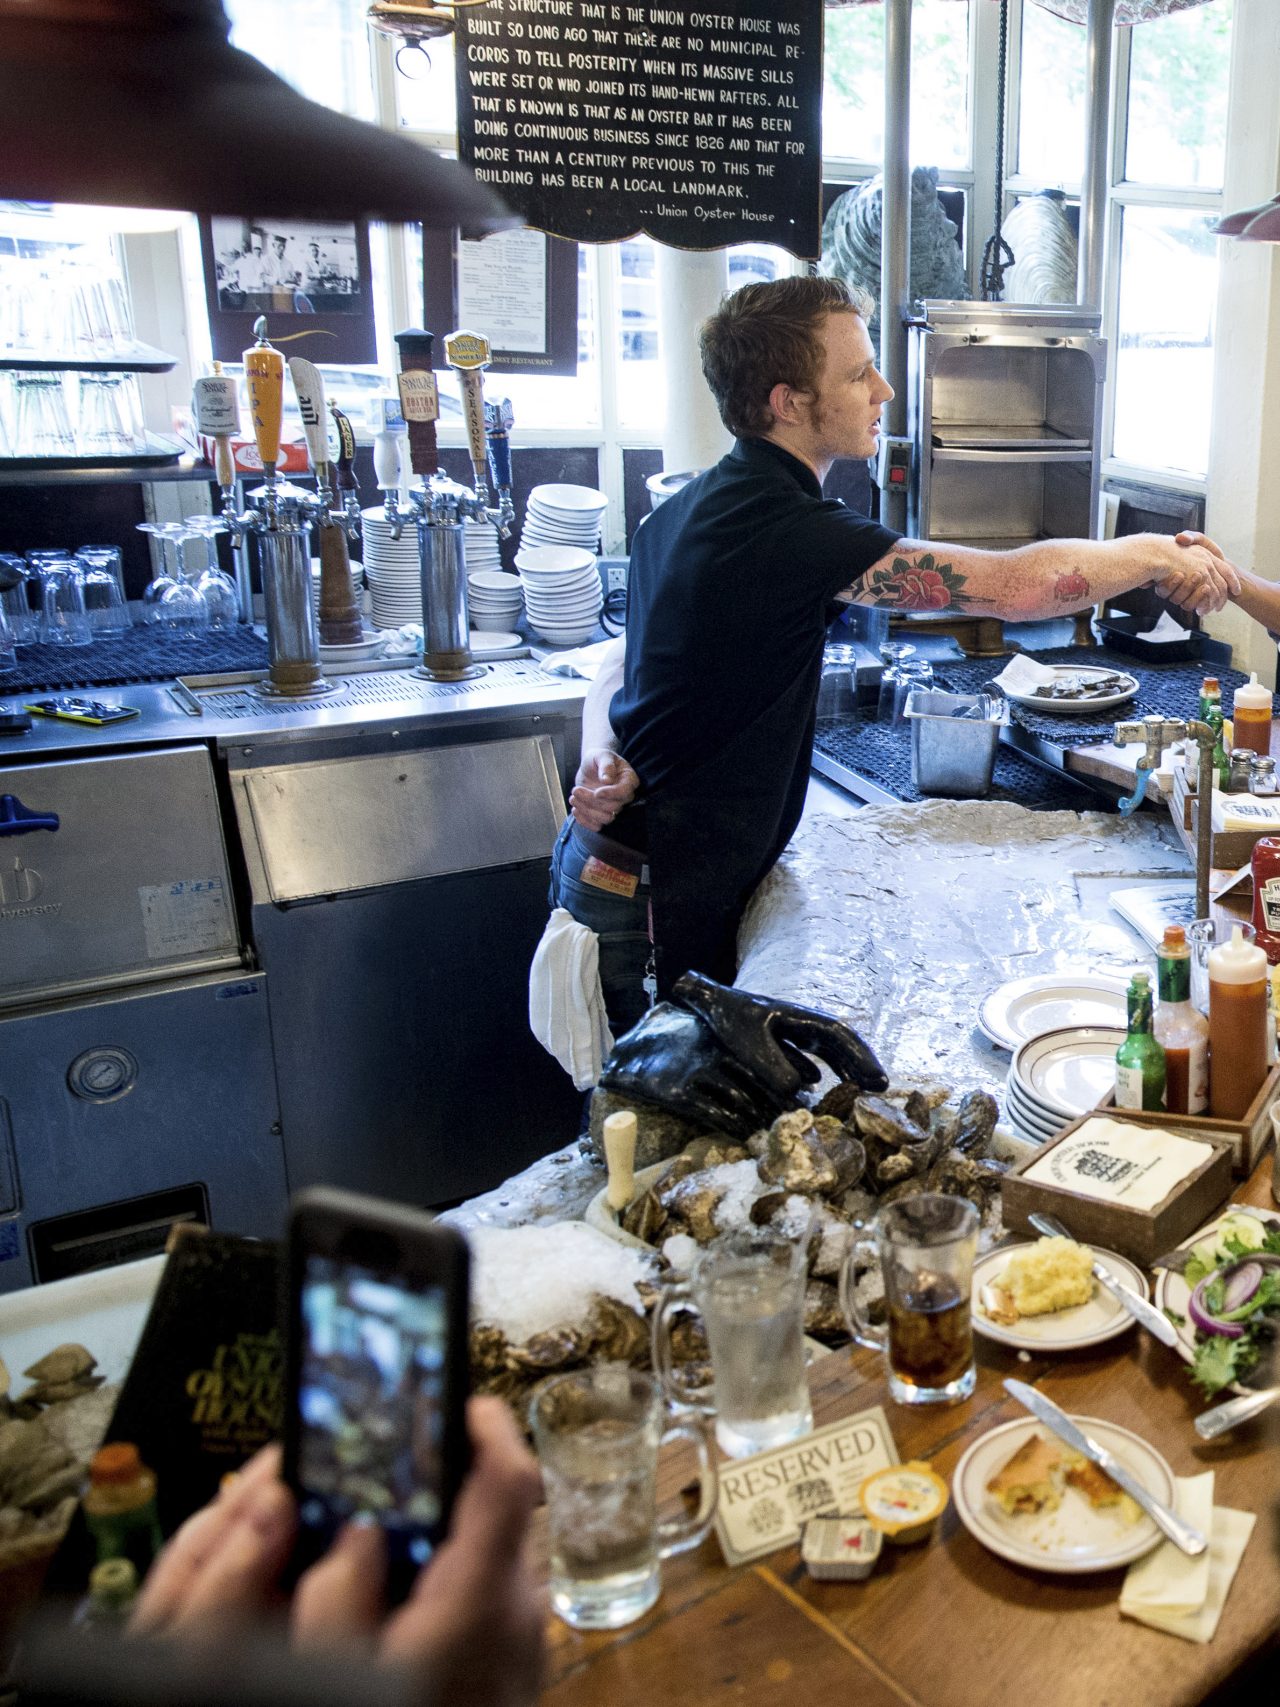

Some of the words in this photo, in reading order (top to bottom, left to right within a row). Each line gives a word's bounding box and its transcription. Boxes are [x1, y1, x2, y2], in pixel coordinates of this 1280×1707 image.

[508, 0, 574, 17] STRUCTURE
[579, 2, 607, 20] THAT
[610, 4, 621, 21] IS
[625, 6, 646, 23] THE
[649, 8, 685, 27] UNION
[689, 12, 735, 31] OYSTER
[739, 16, 773, 34] HOUSE
[776, 21, 801, 36] WAS
[467, 17, 503, 37] BUILT
[506, 21, 524, 38] SO
[527, 23, 560, 41] LONG
[563, 27, 588, 43] AGO
[591, 29, 619, 45] THAT
[623, 31, 658, 48] THERE
[660, 35, 682, 50] ARE
[687, 36, 704, 52] NO
[710, 39, 777, 58] MUNICIPAL
[785, 44, 806, 60] RE-
[467, 43, 510, 65] CORDS
[514, 48, 532, 66] TO
[534, 50, 564, 68] TELL
[568, 52, 638, 73] POSTERITY
[642, 59, 676, 76] WHEN
[680, 61, 698, 78] ITS
[702, 63, 755, 83] MASSIVE
[760, 69, 794, 85] SILLS
[468, 70, 508, 88] WERE
[511, 72, 535, 89] SET
[537, 75, 554, 91] OR
[556, 77, 581, 93] WHO
[585, 79, 625, 96] JOINED
[629, 82, 647, 98] ITS
[651, 84, 715, 103] HAND-HEWN
[719, 89, 772, 107] RAFTERS.
[776, 94, 800, 110] ALL
[471, 95, 502, 113] THAT
[505, 98, 517, 113] IS
[519, 98, 564, 117] KNOWN
[568, 102, 579, 118] IS
[582, 103, 611, 120] THAT
[613, 106, 627, 121] AS
[630, 107, 645, 123] AN
[647, 108, 690, 126] OYSTER
[693, 111, 714, 127] BAR
[717, 114, 728, 128] IT
[731, 114, 755, 130] HAS
[760, 116, 792, 133] BEEN
[473, 118, 509, 137] DOING
[513, 122, 589, 142] CONTINUOUS
[593, 127, 651, 145] BUSINESS
[654, 132, 690, 148] SINCE
[695, 134, 725, 150] 1826
[728, 137, 751, 152] AND
[754, 139, 781, 154] THAT
[785, 140, 806, 156] FOR
[473, 145, 510, 162] MORE
[515, 148, 550, 165] THAN
[554, 151, 565, 166] A
[568, 151, 627, 169] CENTURY
[631, 155, 695, 173] PREVIOUS
[699, 160, 716, 174] TO
[722, 161, 750, 176] THIS
[755, 163, 776, 178] THE
[474, 167, 534, 186] BUILDING
[541, 172, 566, 188] HAS
[571, 174, 604, 190] BEEN
[609, 177, 620, 191] A
[623, 177, 667, 194] LOCAL
[672, 180, 749, 199] LANDMARK.
[656, 203, 688, 218] Union
[693, 205, 736, 223] Oyster
[741, 207, 776, 223] House
[467, 389, 482, 458] SEASONAL
[0, 903, 63, 920] iversey
[721, 1427, 876, 1506] RESERVED
